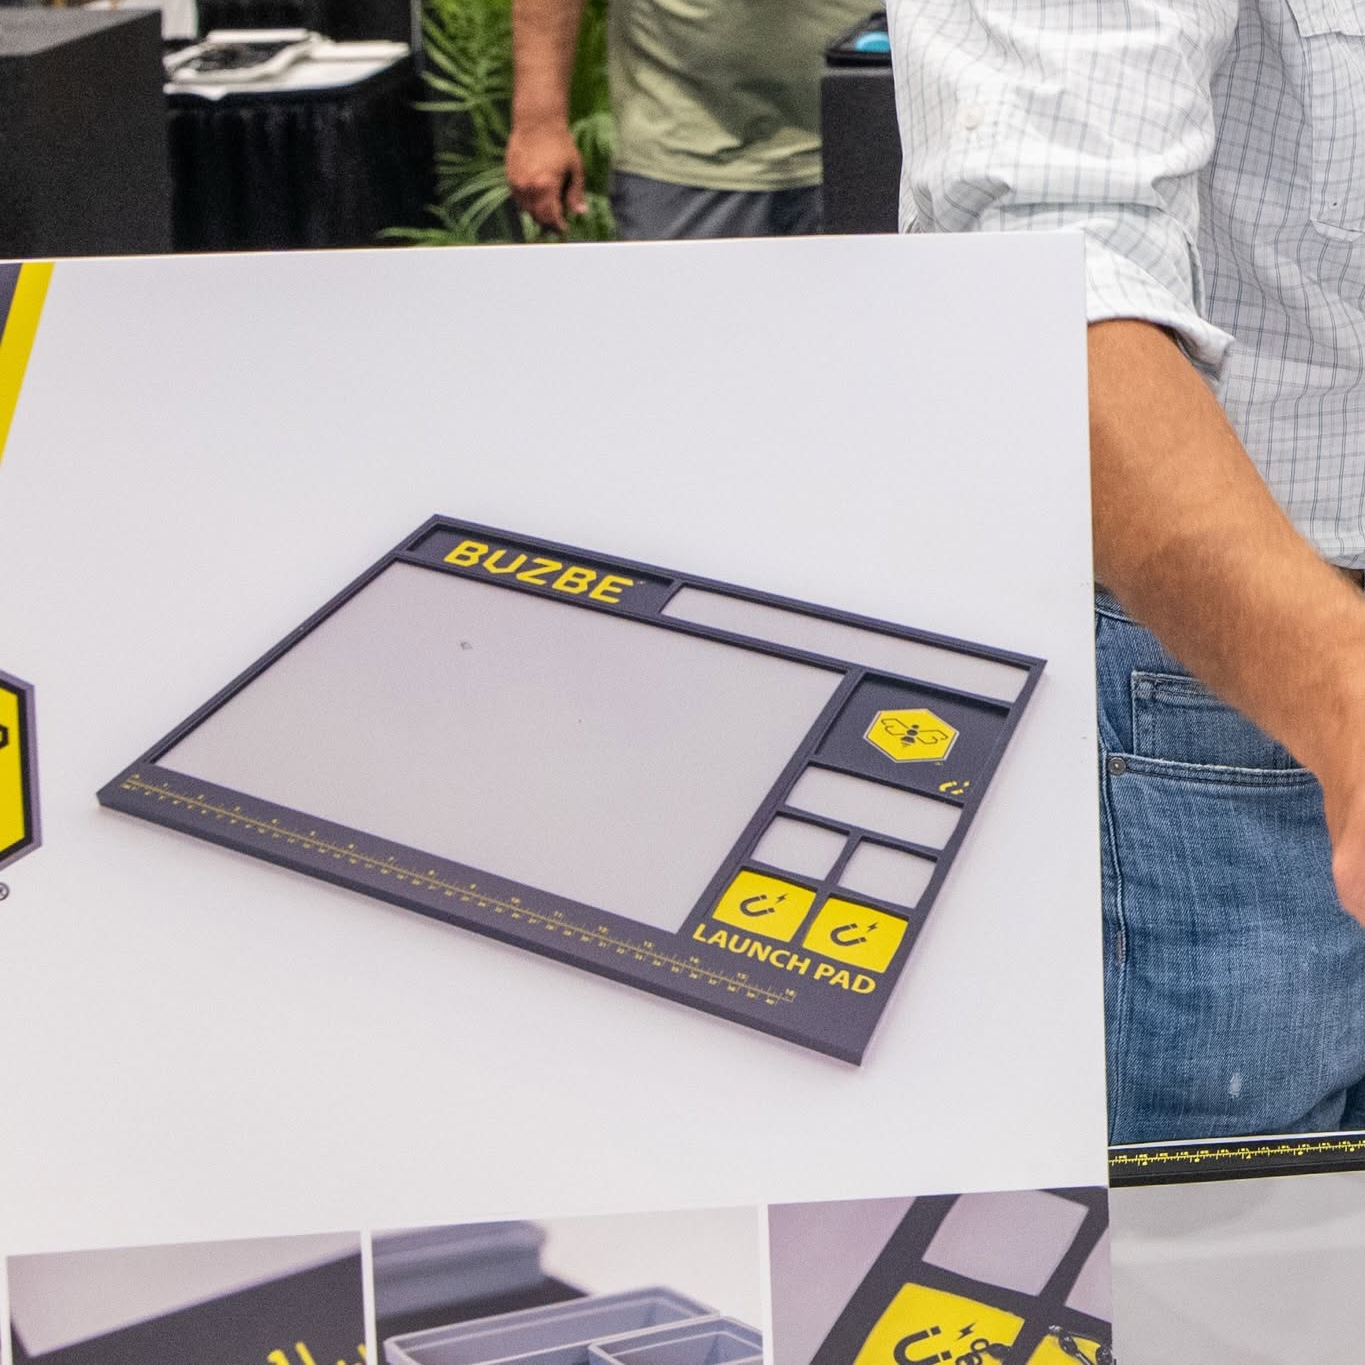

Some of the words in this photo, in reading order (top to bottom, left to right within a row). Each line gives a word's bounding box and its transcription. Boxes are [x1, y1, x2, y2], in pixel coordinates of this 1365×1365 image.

[443, 538, 636, 604] BUZBE
[691, 922, 811, 976] LAUNCH
[812, 963, 877, 996] PAD
